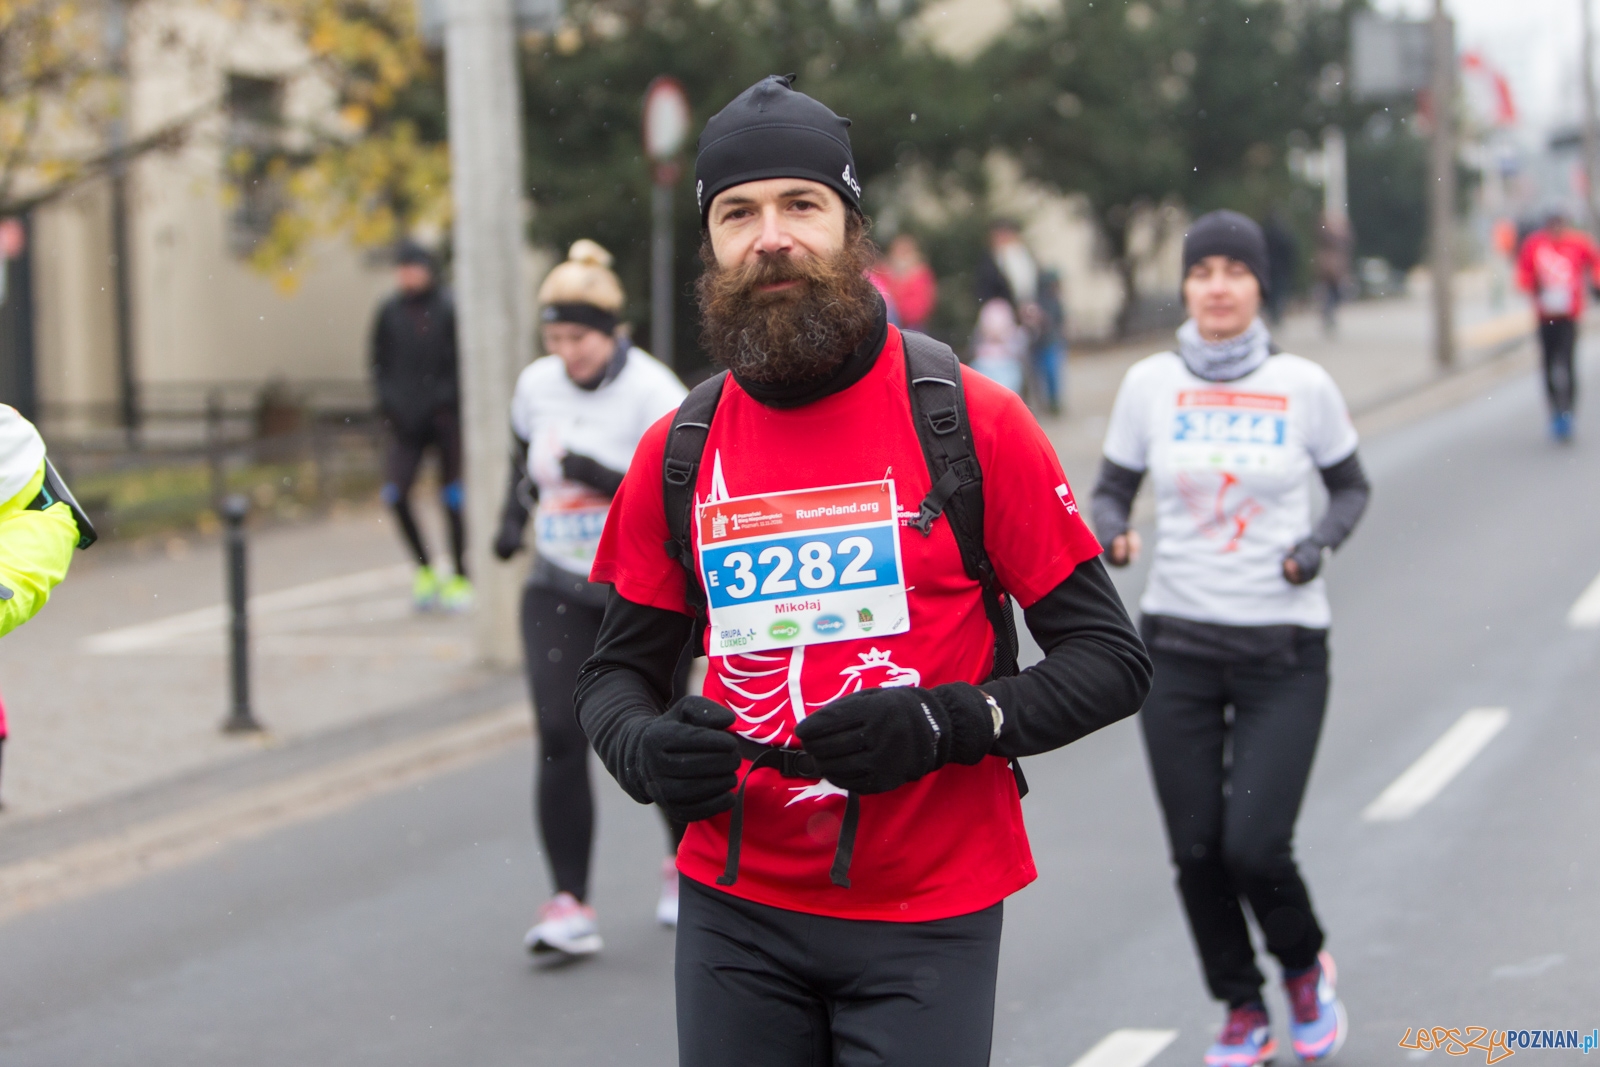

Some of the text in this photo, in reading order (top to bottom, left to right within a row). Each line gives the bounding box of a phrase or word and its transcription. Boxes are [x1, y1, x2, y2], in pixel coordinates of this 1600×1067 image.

[796, 502, 879, 519] RunPoland.org
[708, 536, 877, 599] E 3282
[775, 599, 821, 614] Mikołaj
[720, 629, 742, 639] GRUPA
[720, 637, 747, 648] LUXMED
